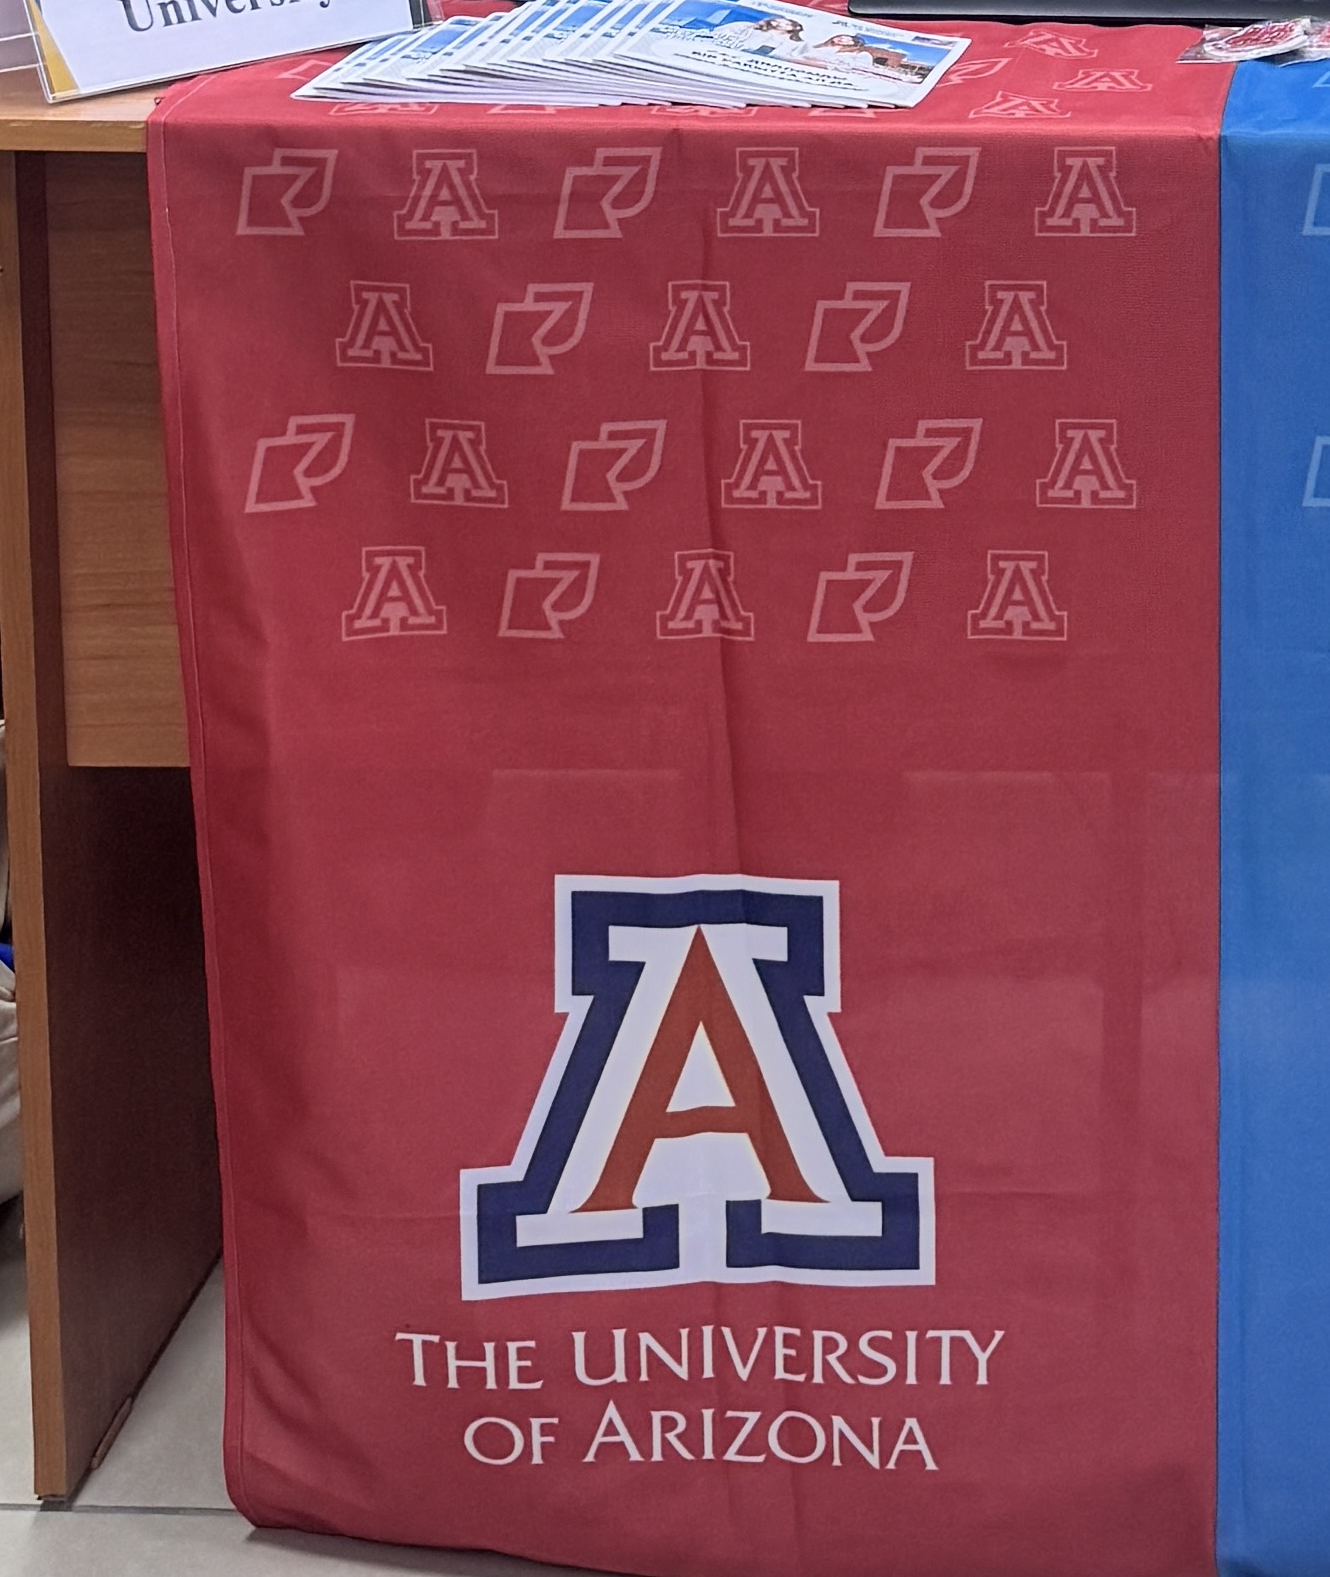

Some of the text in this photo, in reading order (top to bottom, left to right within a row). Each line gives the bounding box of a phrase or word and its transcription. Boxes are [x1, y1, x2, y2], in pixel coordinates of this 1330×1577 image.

[460, 874, 936, 1301] A
[395, 1325, 1006, 1390] THE UNIVERSITY
[463, 1399, 939, 1471] OF ARIZONA
